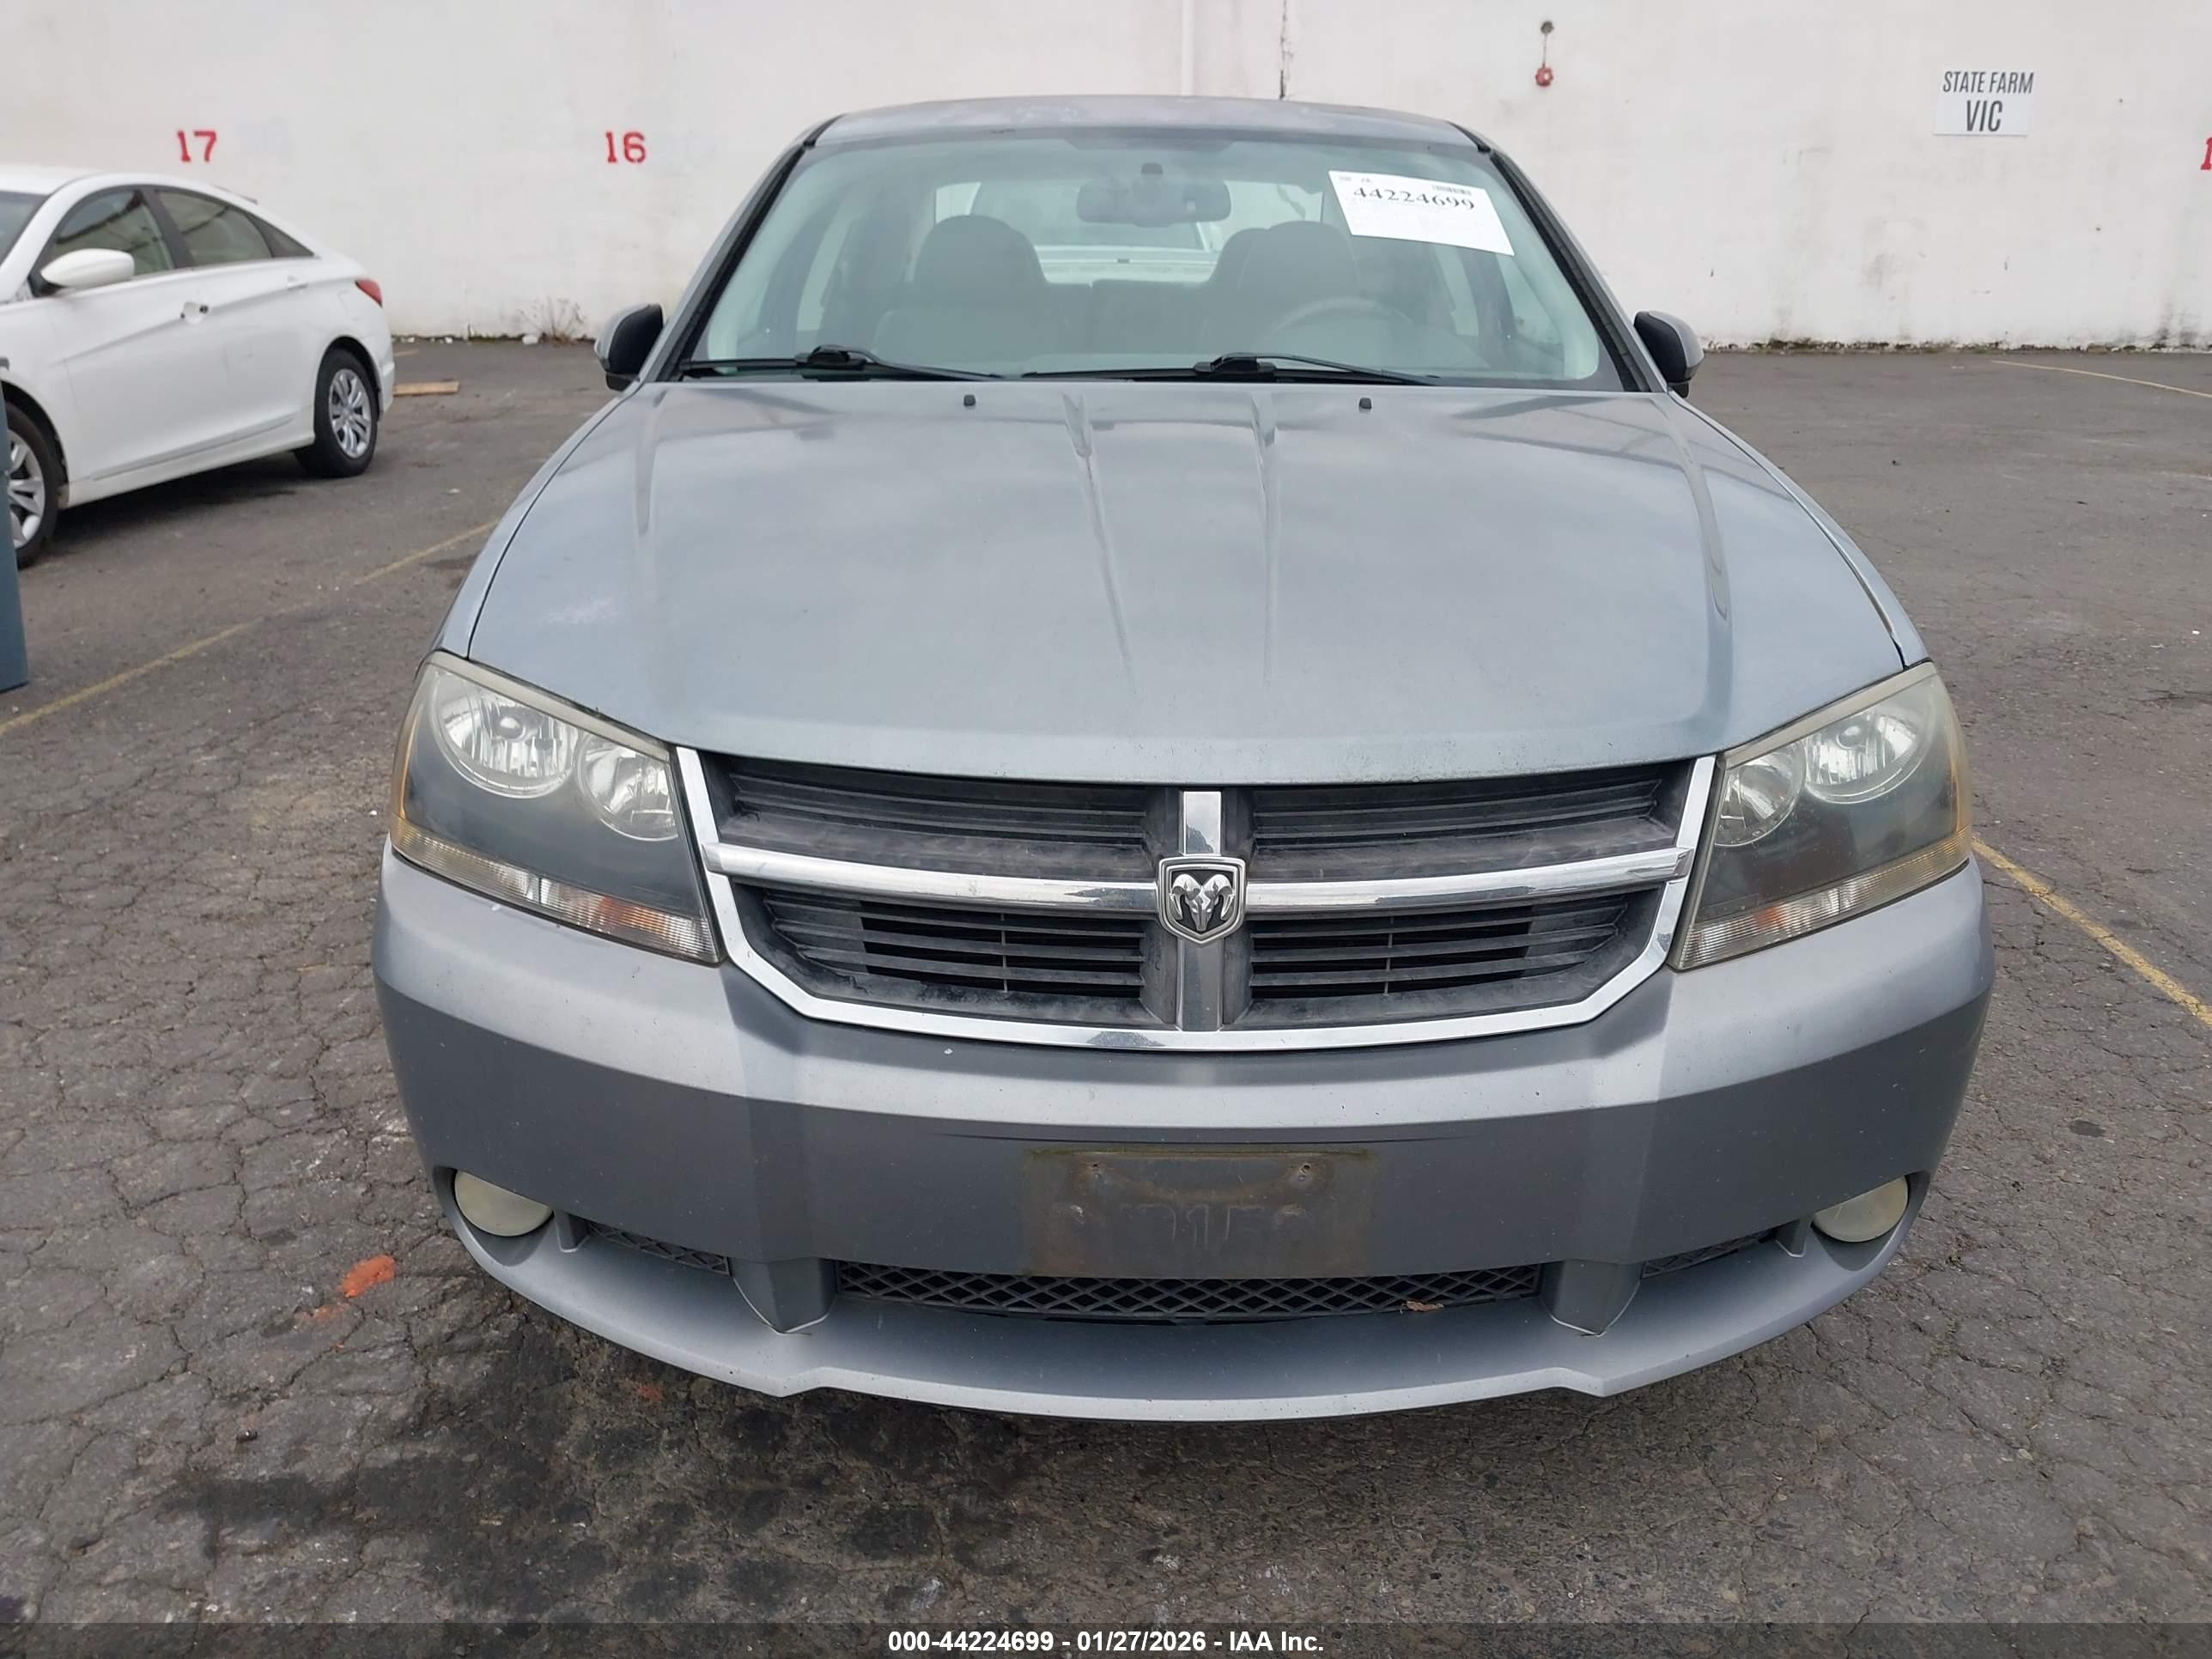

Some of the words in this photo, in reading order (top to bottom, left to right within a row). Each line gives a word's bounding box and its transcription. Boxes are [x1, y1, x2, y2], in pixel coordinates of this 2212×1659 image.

[1942, 70, 1986, 93] STATE
[1989, 71, 2034, 94] FARM
[1966, 100, 2002, 131] VIC
[177, 129, 217, 163] 17
[605, 131, 647, 165] 16
[1353, 185, 1475, 210] 44224699
